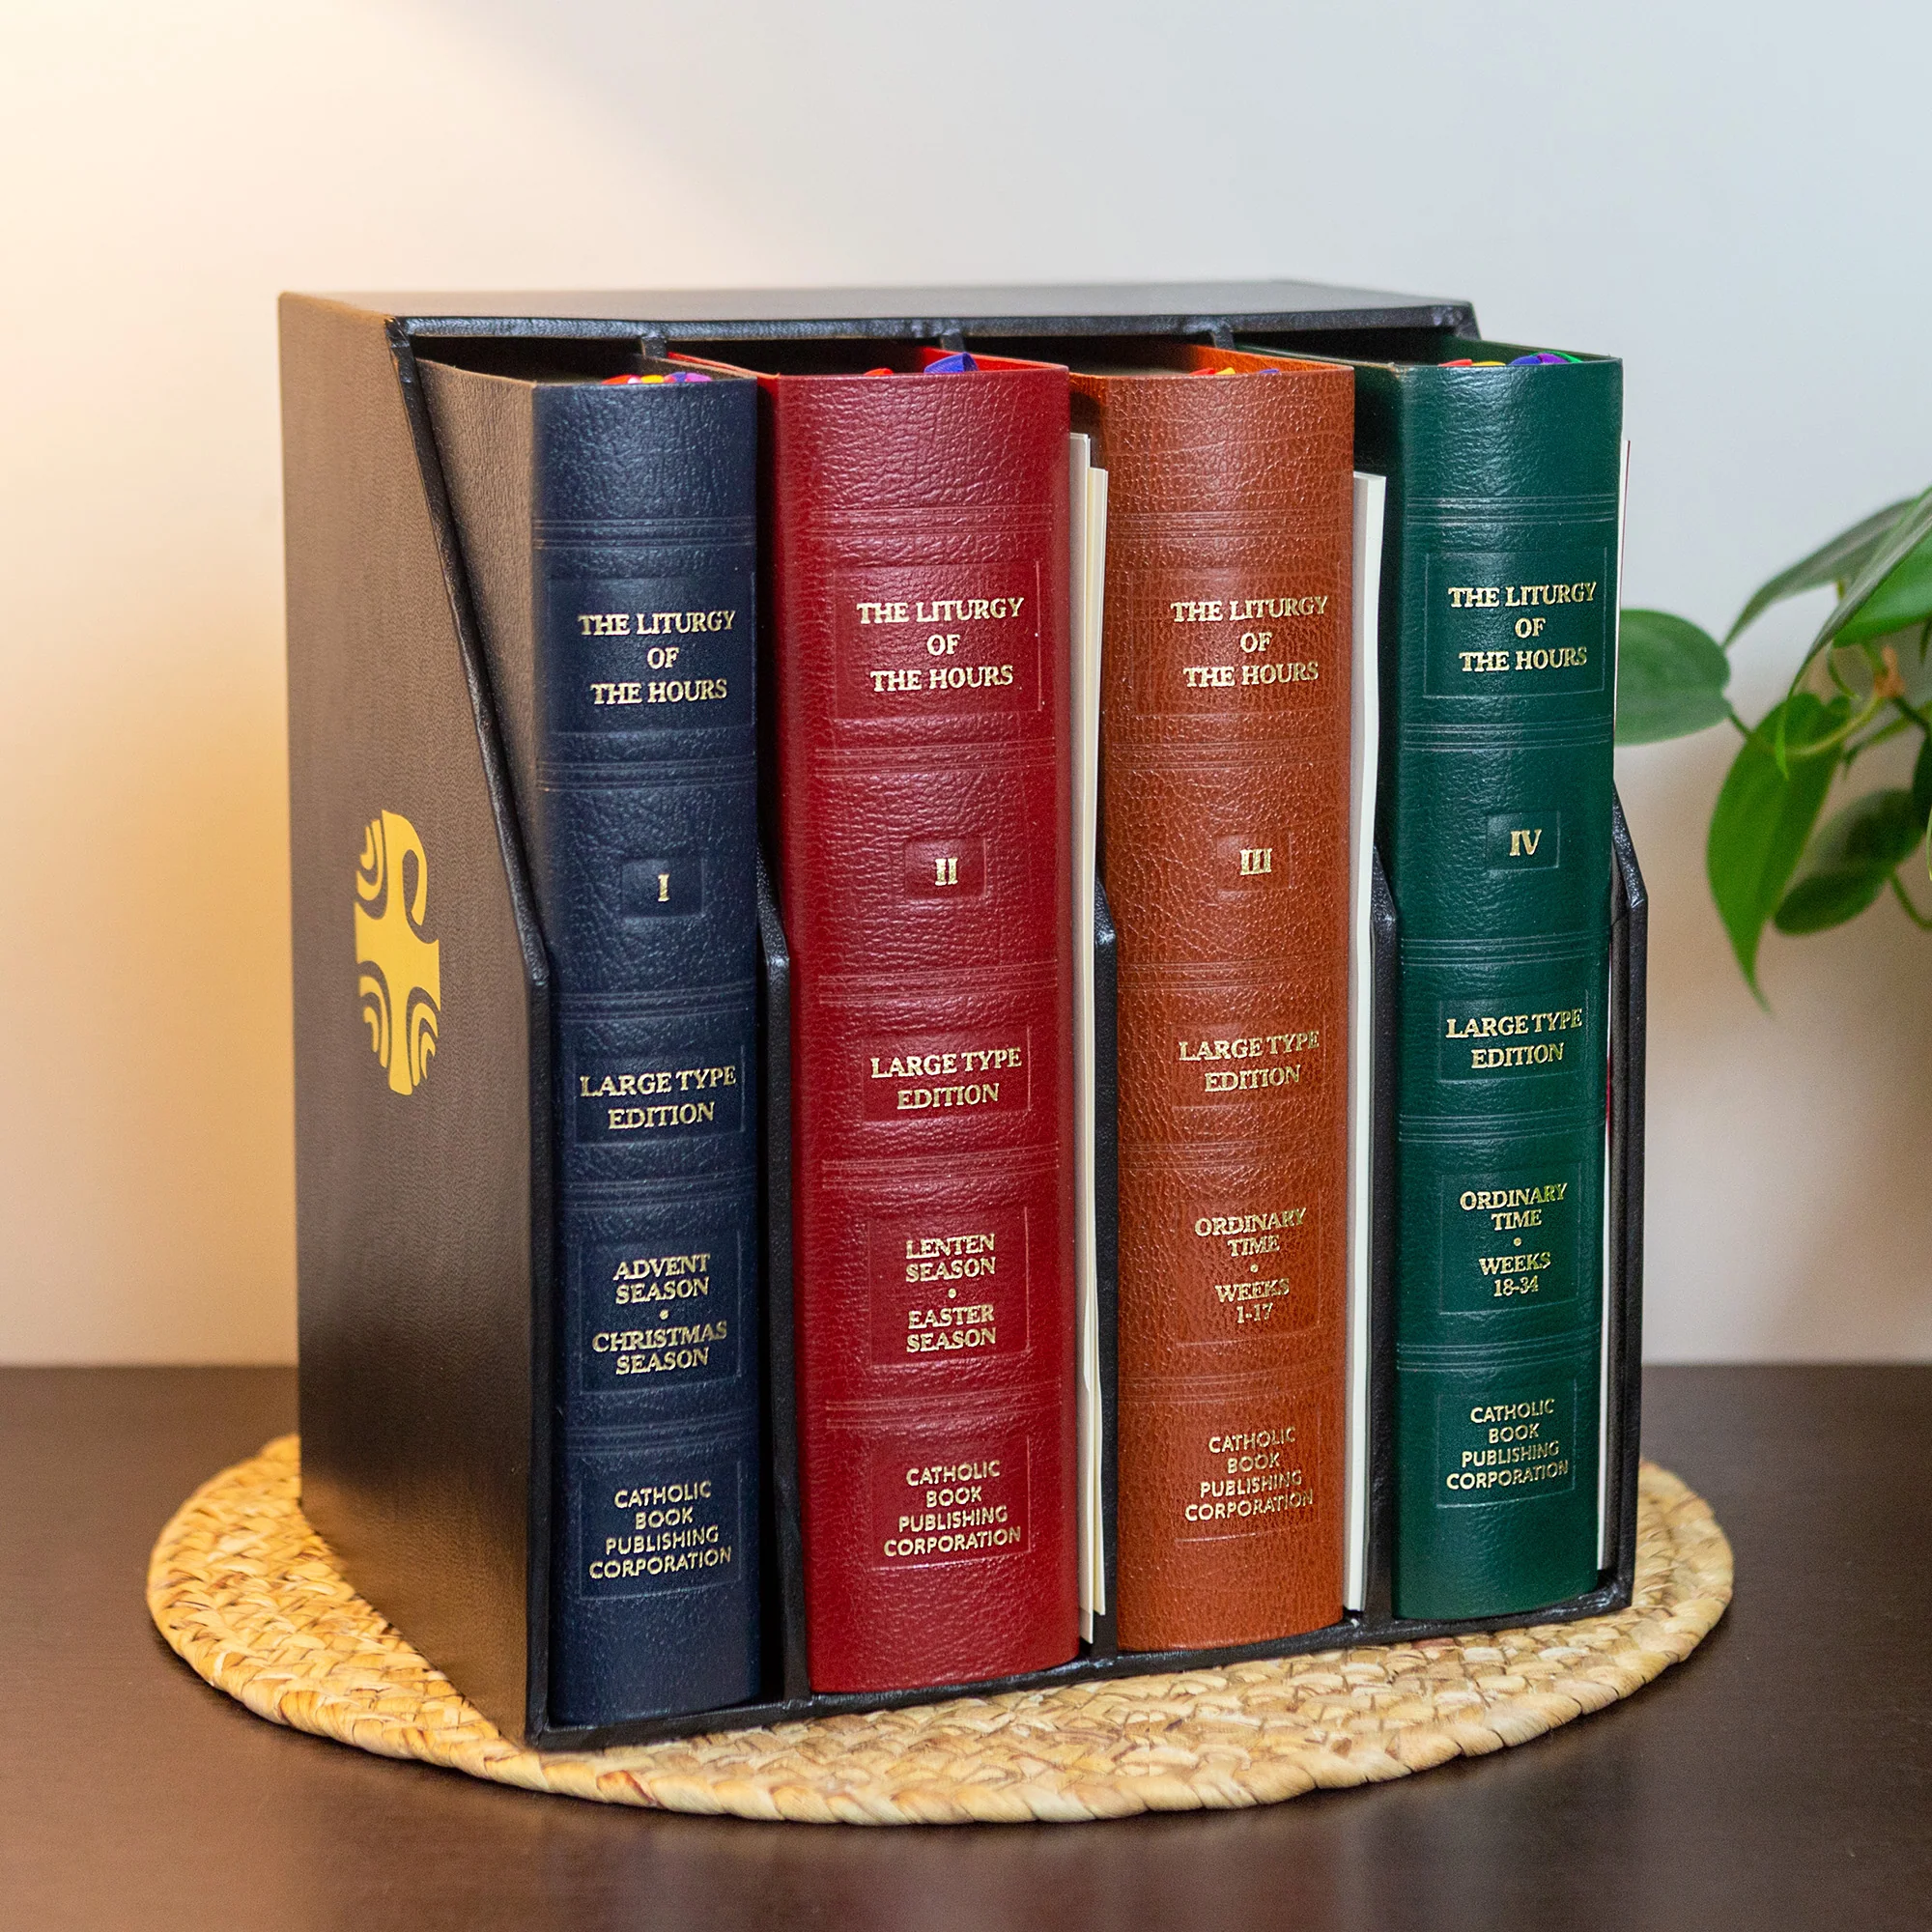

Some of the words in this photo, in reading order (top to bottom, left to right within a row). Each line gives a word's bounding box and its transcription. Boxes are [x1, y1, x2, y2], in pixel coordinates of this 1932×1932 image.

[1170, 600, 1223, 623] THE
[1229, 595, 1328, 622] LITURGY
[1447, 585, 1499, 609] THE
[1504, 582, 1597, 608] LITURGY
[578, 612, 631, 636] THE
[636, 610, 736, 635] LITURGY
[856, 601, 909, 625] THE
[916, 596, 1025, 623] LITURGY
[1239, 631, 1272, 653] OF
[1515, 617, 1546, 639] OF
[646, 646, 679, 669] OF
[926, 633, 961, 656] OF
[1459, 650, 1510, 672] THE
[1515, 645, 1588, 671] HOURS
[869, 668, 923, 693] THE
[928, 664, 1014, 691] HOURS
[1182, 666, 1236, 689] THE
[1240, 661, 1319, 687] HOURS
[589, 681, 642, 705] THE
[646, 678, 727, 704] HOURS
[1509, 828, 1542, 857] IV
[933, 857, 958, 886] II
[1239, 847, 1273, 876] III
[657, 873, 670, 902] I
[1445, 1013, 1528, 1039] LARGE
[1531, 1008, 1582, 1034] TYPE
[1179, 1037, 1264, 1062] LARGE
[1265, 1030, 1320, 1057] TYPE
[1470, 1041, 1565, 1070] EDITION
[869, 1053, 957, 1079] LARGE
[960, 1046, 1022, 1072] TYPE
[579, 1071, 672, 1097] LARGE
[675, 1065, 737, 1092] TYPE
[1205, 1064, 1301, 1094] EDITION
[896, 1083, 1000, 1110] EDITION
[608, 1101, 715, 1130] EDITION
[1460, 1182, 1568, 1212] ORDINARY
[1194, 1208, 1307, 1237] ORDINARY
[1491, 1208, 1543, 1232] TIME
[905, 1233, 995, 1260] LENTEN
[1227, 1234, 1280, 1258] TIME
[612, 1253, 711, 1281] ADVENT
[905, 1256, 996, 1284] SEASON
[1478, 1251, 1551, 1277] WEEKS
[614, 1276, 710, 1305] SEASON
[1214, 1277, 1290, 1304] WEEKS
[1493, 1275, 1539, 1298] 18-34
[907, 1303, 995, 1329] EASTER
[1236, 1302, 1274, 1324] 1-17
[591, 1320, 727, 1353] CHRISTMAS
[906, 1326, 996, 1353] SEASON
[615, 1347, 710, 1376] SEASON
[1470, 1398, 1555, 1425] CATHOLIC
[1208, 1426, 1295, 1454] CATHOLIC
[1488, 1423, 1540, 1445] BOOK
[1227, 1452, 1280, 1474] BOOK
[1461, 1440, 1560, 1469] PUBLISHING
[905, 1459, 1001, 1487] CATHOLIC
[1199, 1469, 1302, 1498] PUBLISHING
[1446, 1459, 1569, 1491] CORPORATION
[613, 1480, 712, 1509] CATHOLIC
[925, 1485, 982, 1509] BOOK
[1184, 1489, 1314, 1522] CORPORATION
[635, 1505, 694, 1530] BOOK
[898, 1505, 1009, 1533] PUBLISHING
[605, 1524, 720, 1555] PUBLISHING
[883, 1525, 1021, 1557] CORPORATION
[589, 1546, 731, 1579] CORPORATION
